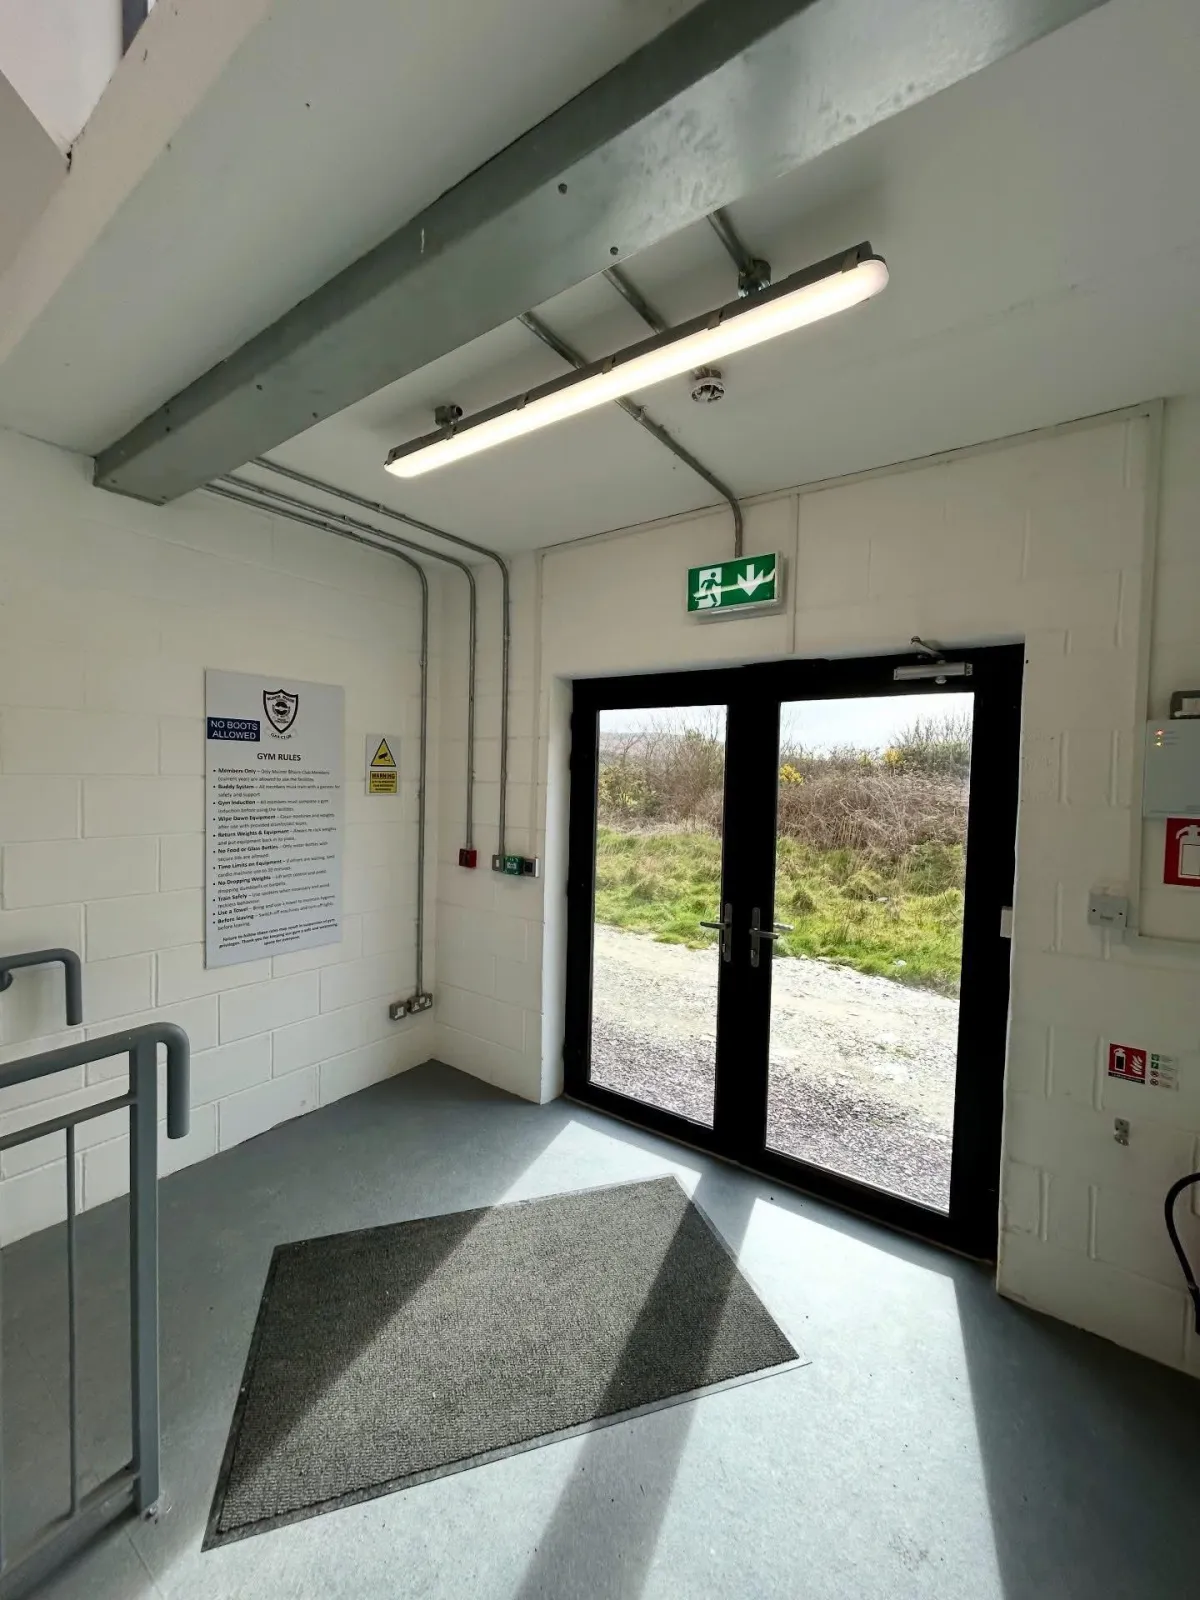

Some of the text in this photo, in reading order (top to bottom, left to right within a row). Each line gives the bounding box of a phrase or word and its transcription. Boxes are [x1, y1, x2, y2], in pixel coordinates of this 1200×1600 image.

[211, 720, 258, 731] NO BOOTS
[212, 730, 256, 740] ALLOWED
[257, 752, 301, 762] GYM RULES
[236, 829, 257, 837] Weights
[263, 828, 289, 836] Equipment
[256, 859, 282, 867] Equipment
[227, 878, 250, 886] Dropping
